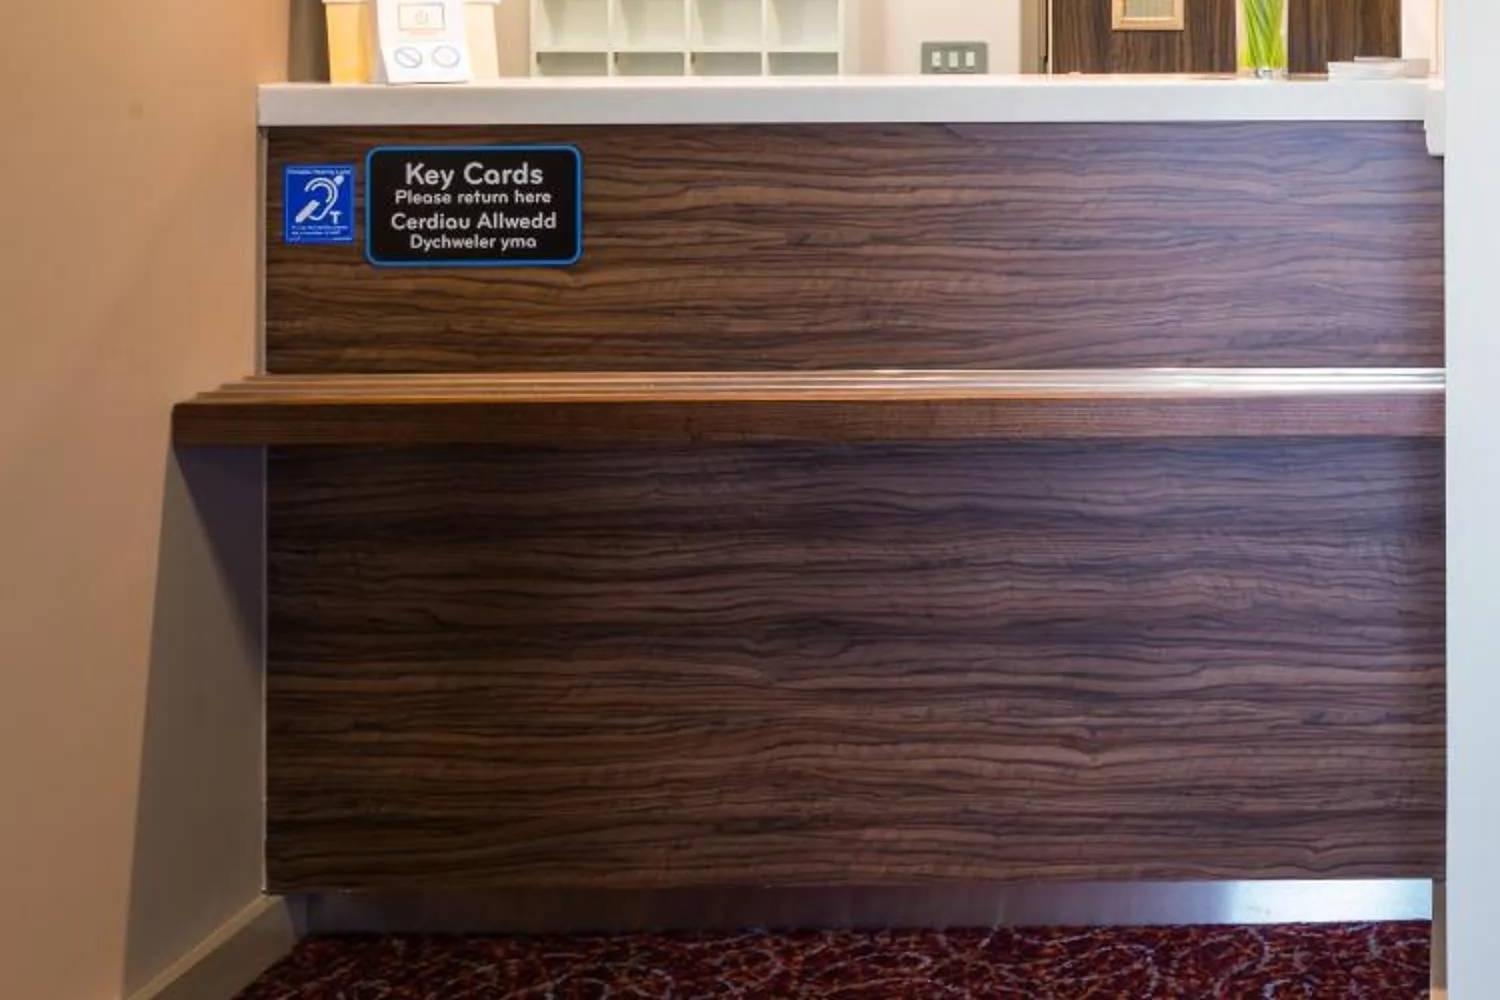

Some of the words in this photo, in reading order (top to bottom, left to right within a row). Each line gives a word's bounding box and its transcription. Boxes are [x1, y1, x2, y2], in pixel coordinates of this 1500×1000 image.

[405, 161, 455, 190] Key
[463, 161, 544, 185] Cards
[395, 189, 452, 204] Please
[457, 190, 509, 204] return
[514, 189, 552, 204] here
[391, 212, 471, 230] Cerdiau
[477, 211, 557, 229] Allwedd
[410, 233, 496, 252] Dychweler
[500, 236, 537, 251] yma
